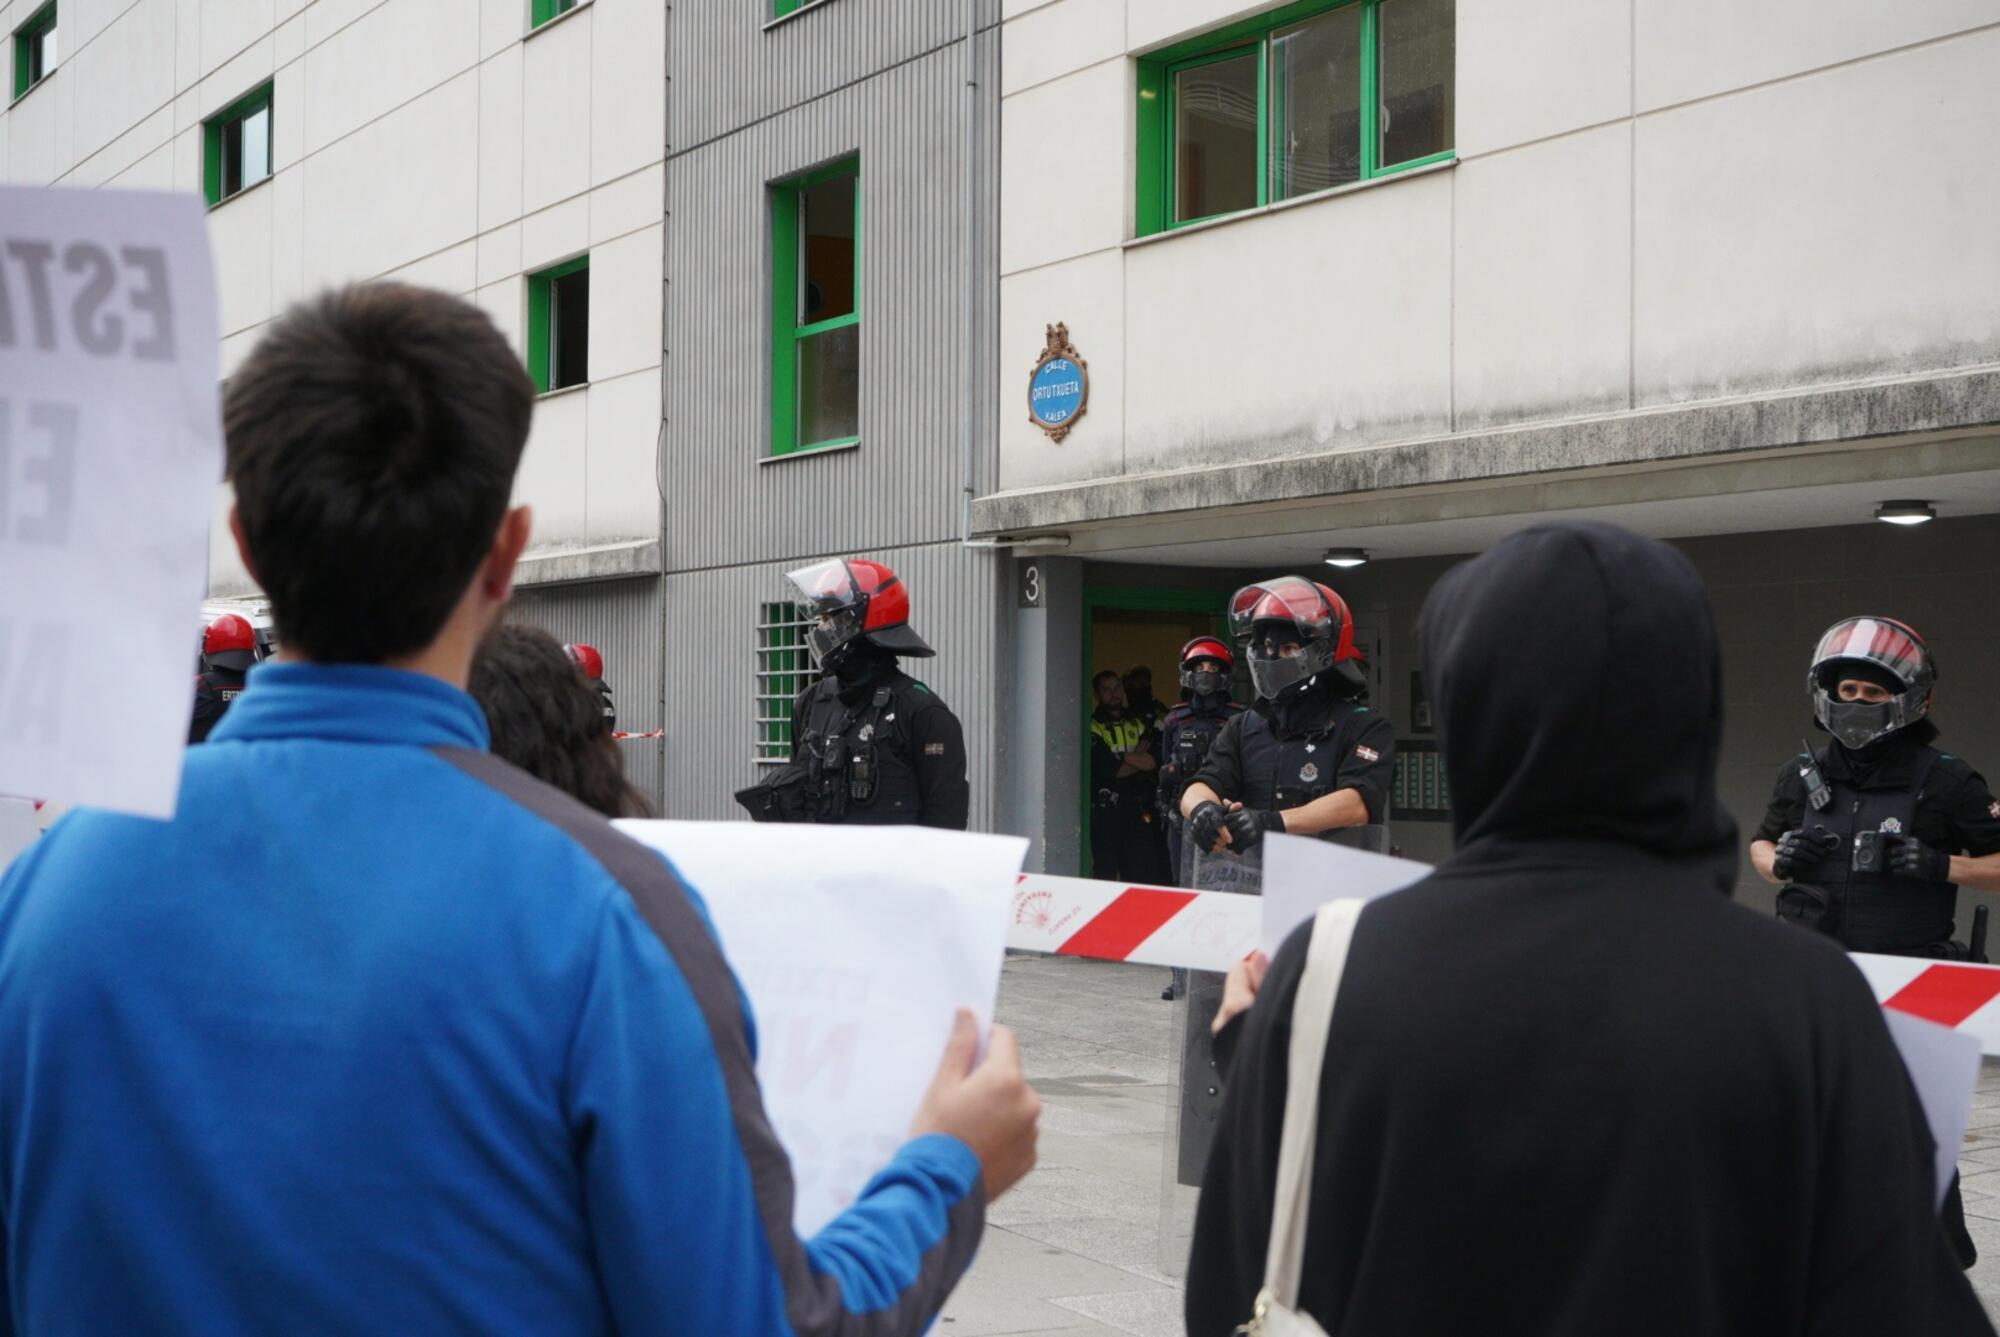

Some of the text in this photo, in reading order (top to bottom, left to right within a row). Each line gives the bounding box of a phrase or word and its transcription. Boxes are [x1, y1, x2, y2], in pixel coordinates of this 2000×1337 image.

[1045, 359, 1068, 373] CALLE
[1045, 410, 1067, 421] KALEA
[1026, 566, 1039, 601] 3
